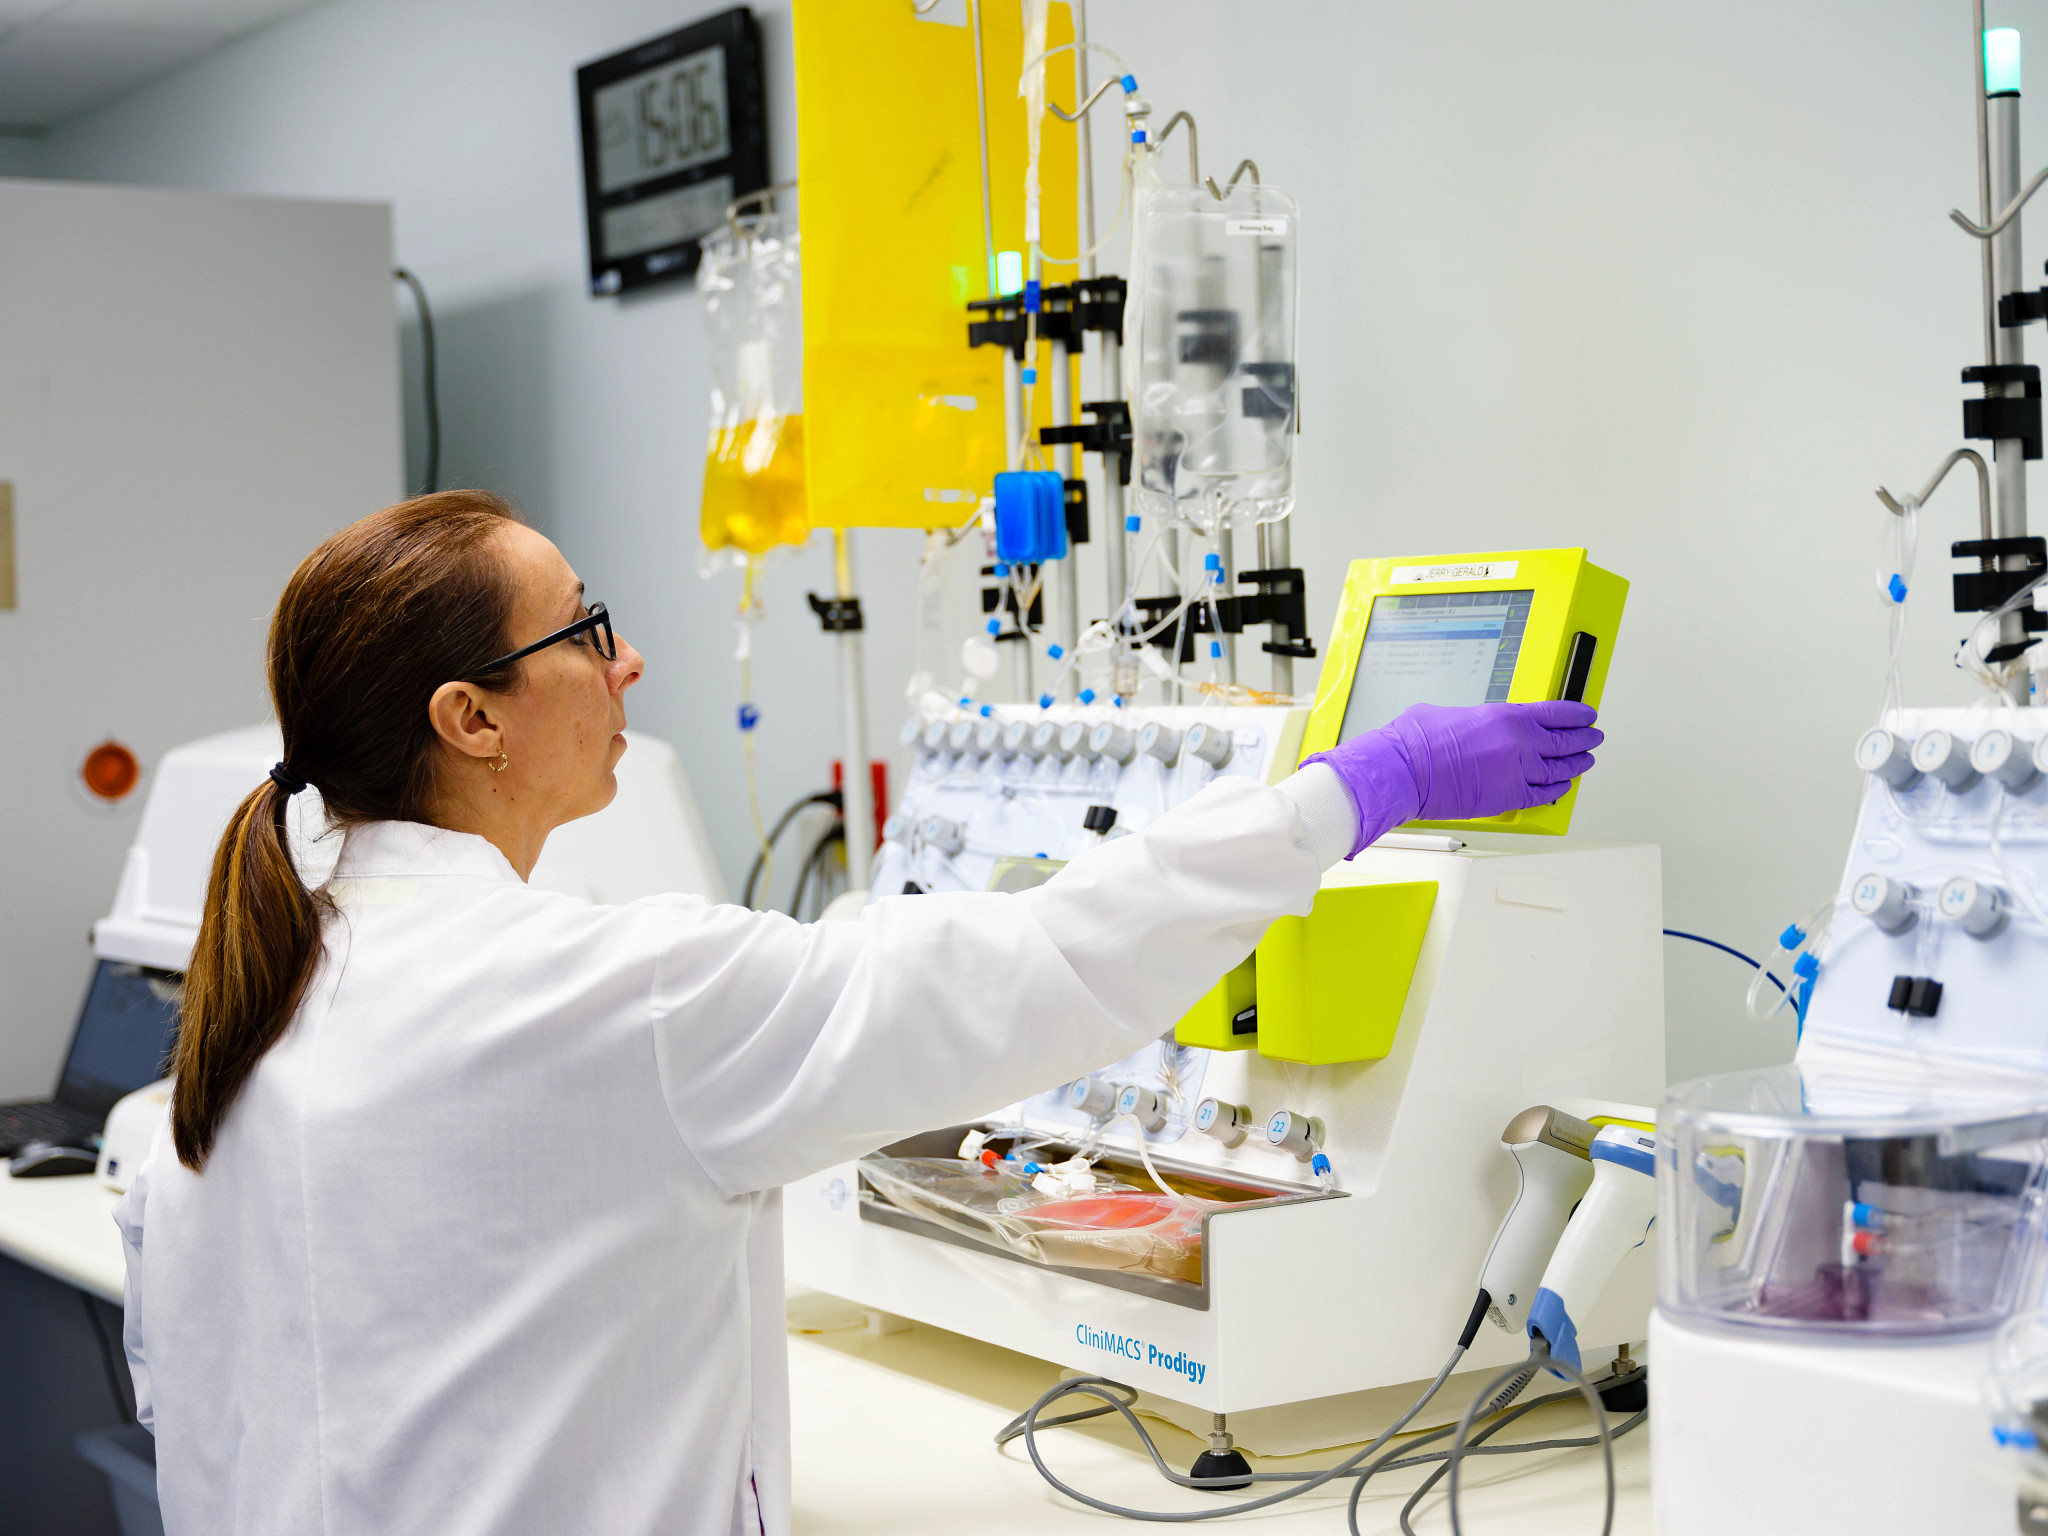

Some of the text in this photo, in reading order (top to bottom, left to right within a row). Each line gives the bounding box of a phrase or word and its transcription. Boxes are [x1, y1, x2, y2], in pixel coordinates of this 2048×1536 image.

[637, 66, 721, 169] 15:06
[1452, 566, 1484, 577] GERALD
[1927, 742, 1936, 756] 2
[1860, 885, 1877, 900] 23
[1947, 888, 1965, 903] 24
[1075, 1086, 1086, 1099] 19
[1123, 1094, 1134, 1107] 20
[1200, 1107, 1212, 1120] 21
[1272, 1120, 1285, 1133] 22
[1148, 1343, 1206, 1385] Prodigy
